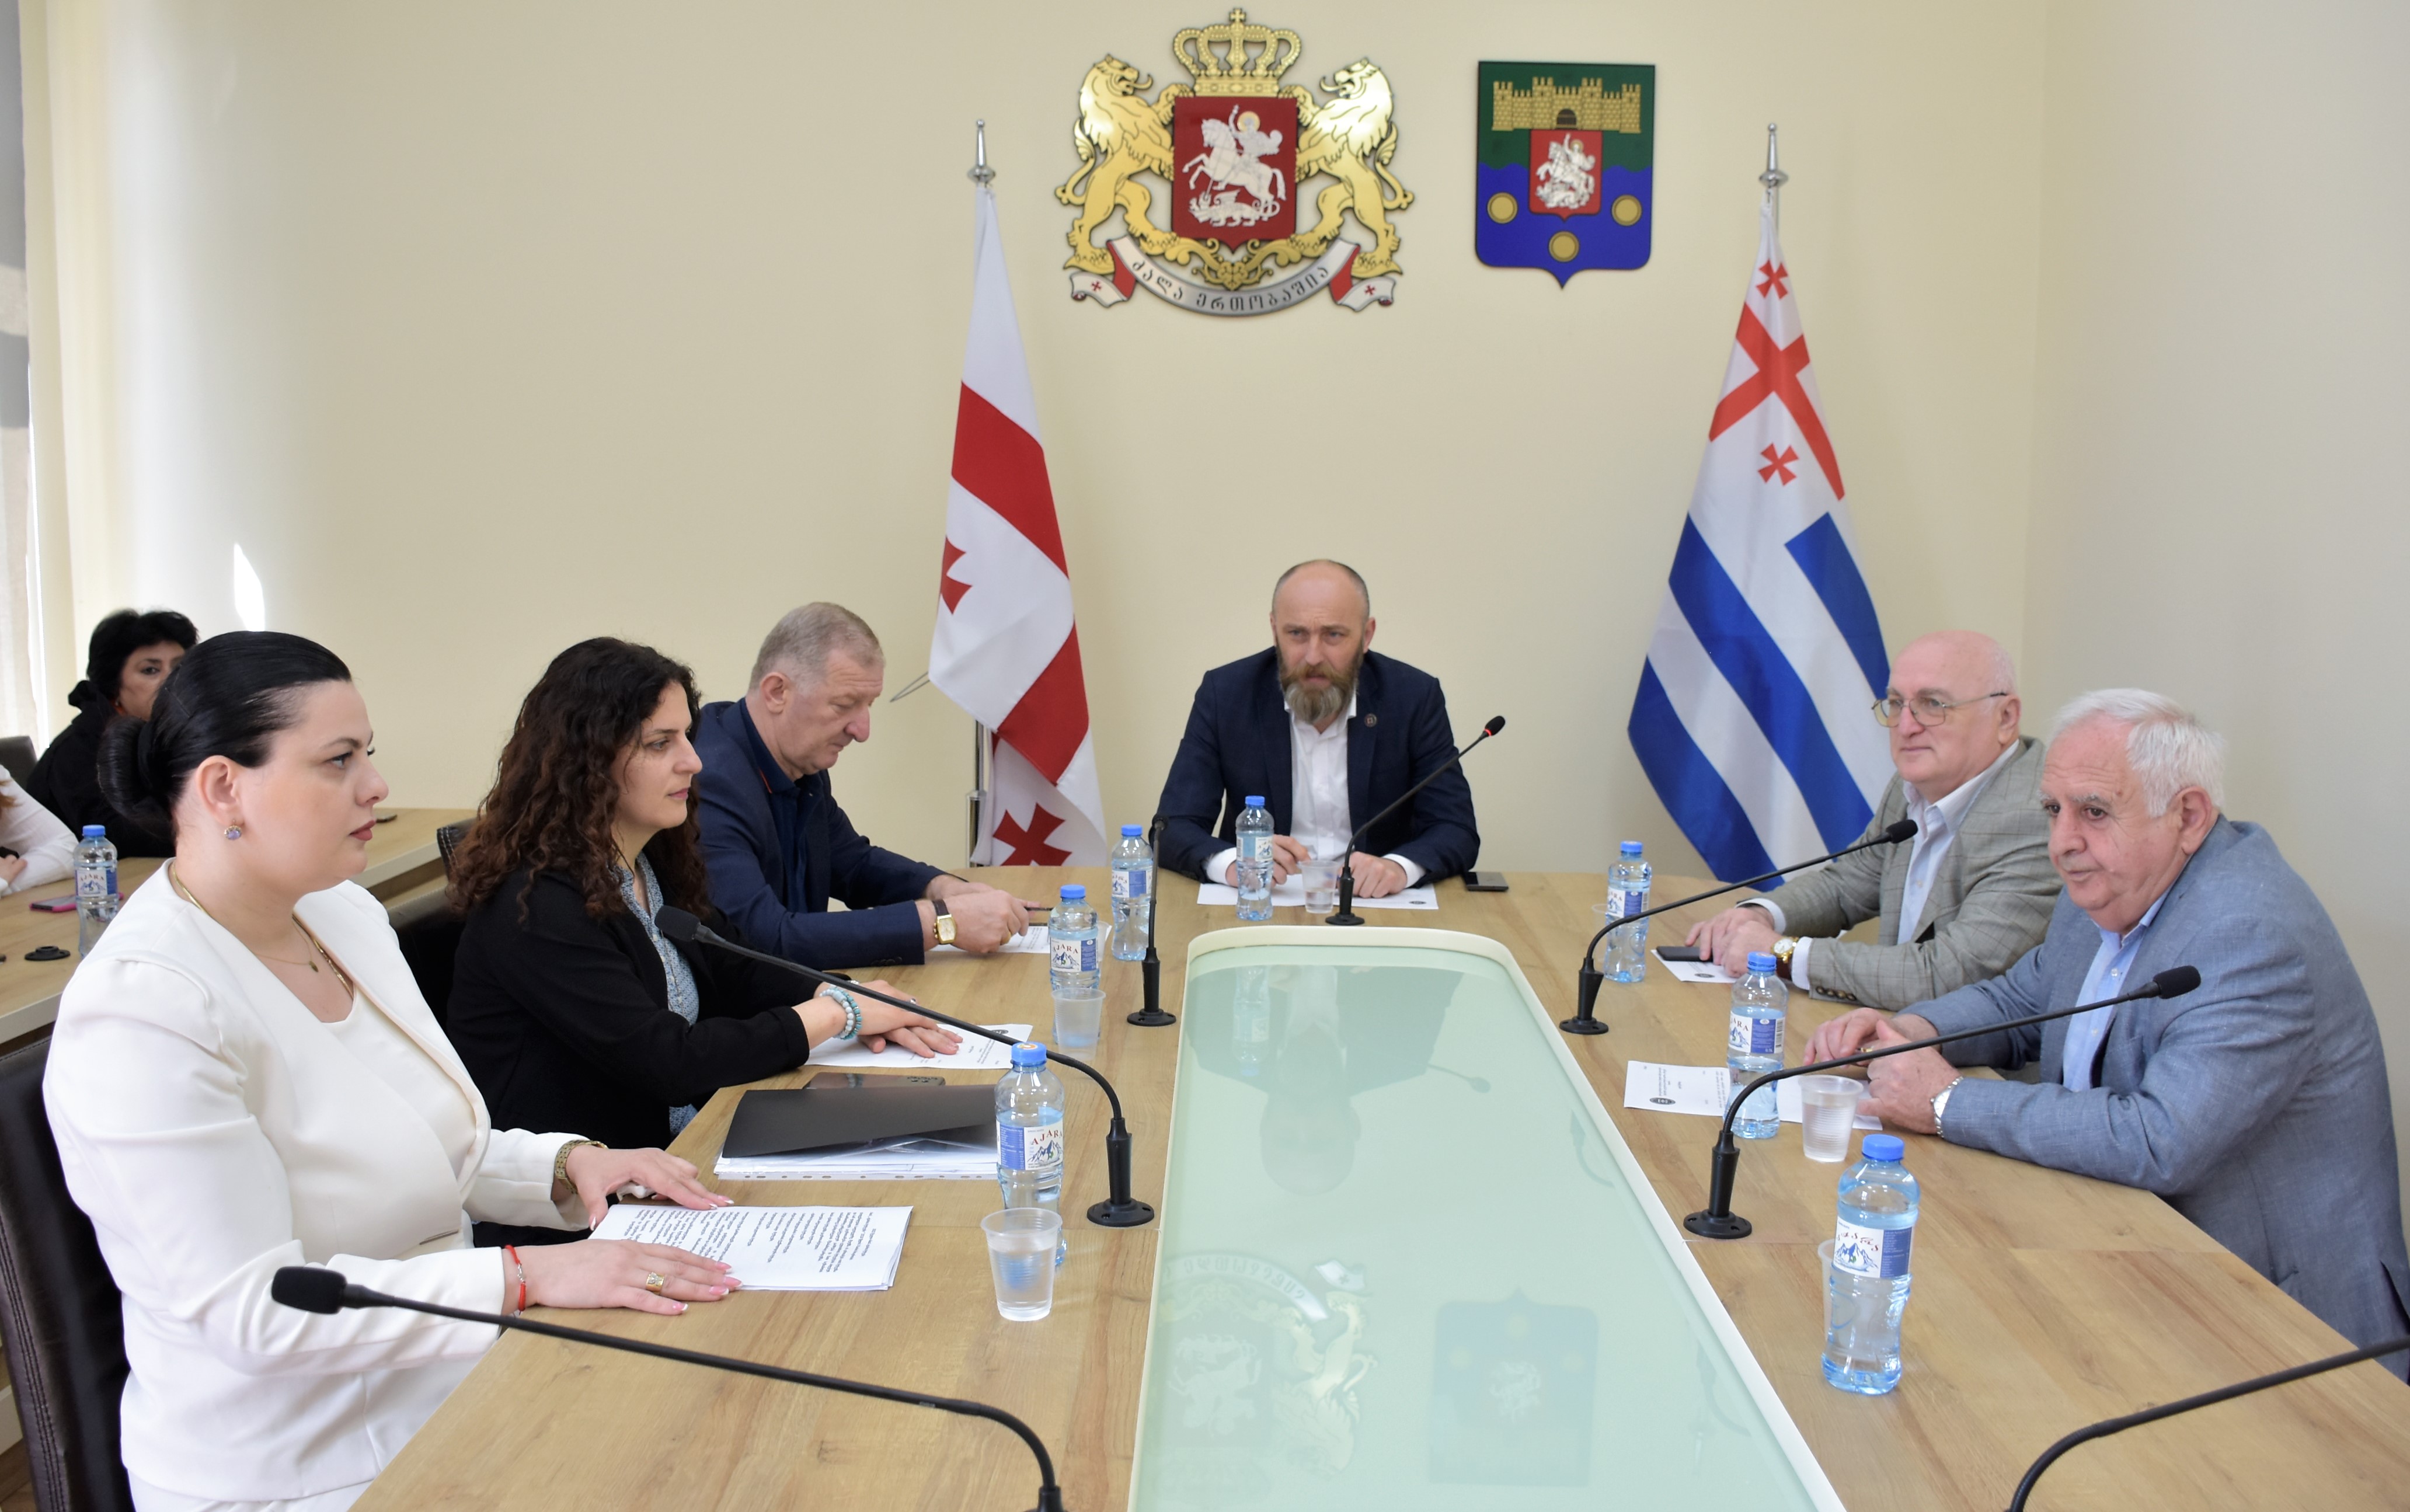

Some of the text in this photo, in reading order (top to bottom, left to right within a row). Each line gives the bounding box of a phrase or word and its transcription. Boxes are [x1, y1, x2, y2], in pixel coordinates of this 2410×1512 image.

[1131, 260, 1329, 312] ძალა ერთობაშია
[1052, 943, 1078, 954] AJARA
[1030, 1129, 1063, 1145] AJARA
